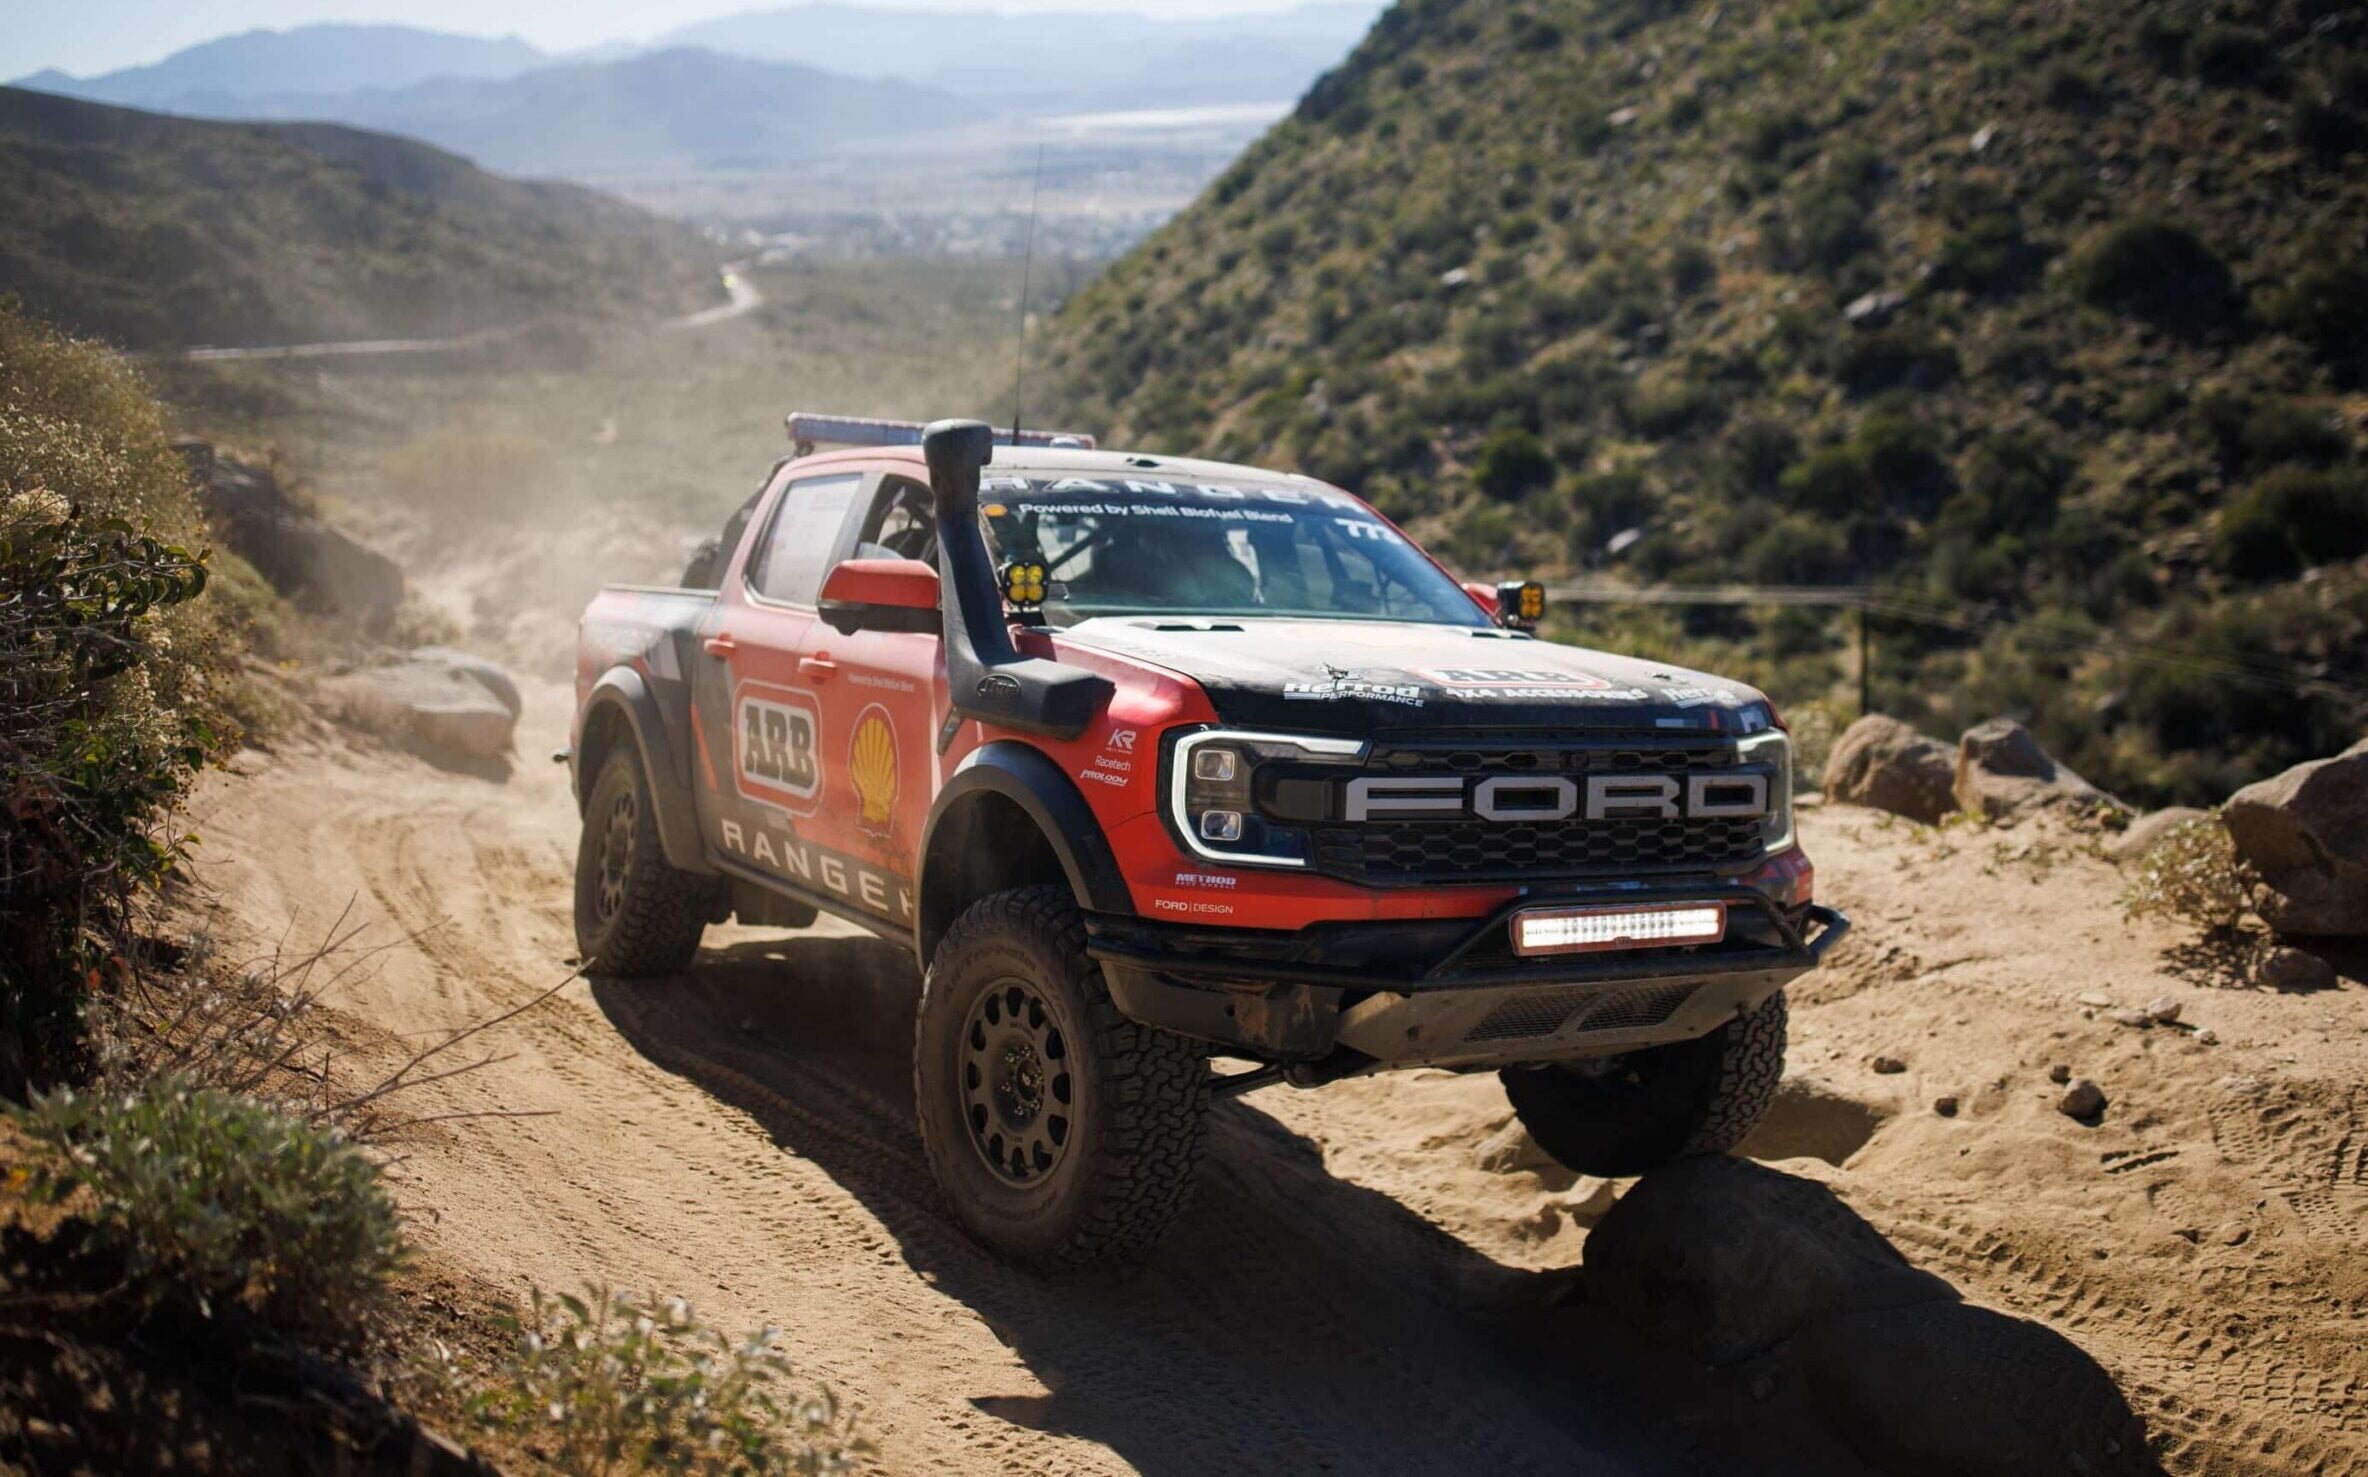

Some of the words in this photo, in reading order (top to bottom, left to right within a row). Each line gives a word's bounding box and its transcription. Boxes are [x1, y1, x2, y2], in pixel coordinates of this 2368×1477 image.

[1018, 503, 1102, 516] Powered
[1104, 505, 1128, 516] by
[1131, 505, 1180, 517] Shell
[1179, 506, 1243, 520] Biofuel
[1243, 510, 1294, 524] Blend
[1320, 690, 1425, 708] PERFORMANCE
[745, 704, 817, 789] ARB
[1108, 728, 1136, 750] KR
[1345, 775, 1768, 822] FORD
[1176, 873, 1236, 885] METHOD
[1155, 899, 1188, 911] FORD
[1193, 902, 1234, 914] DESIGN
